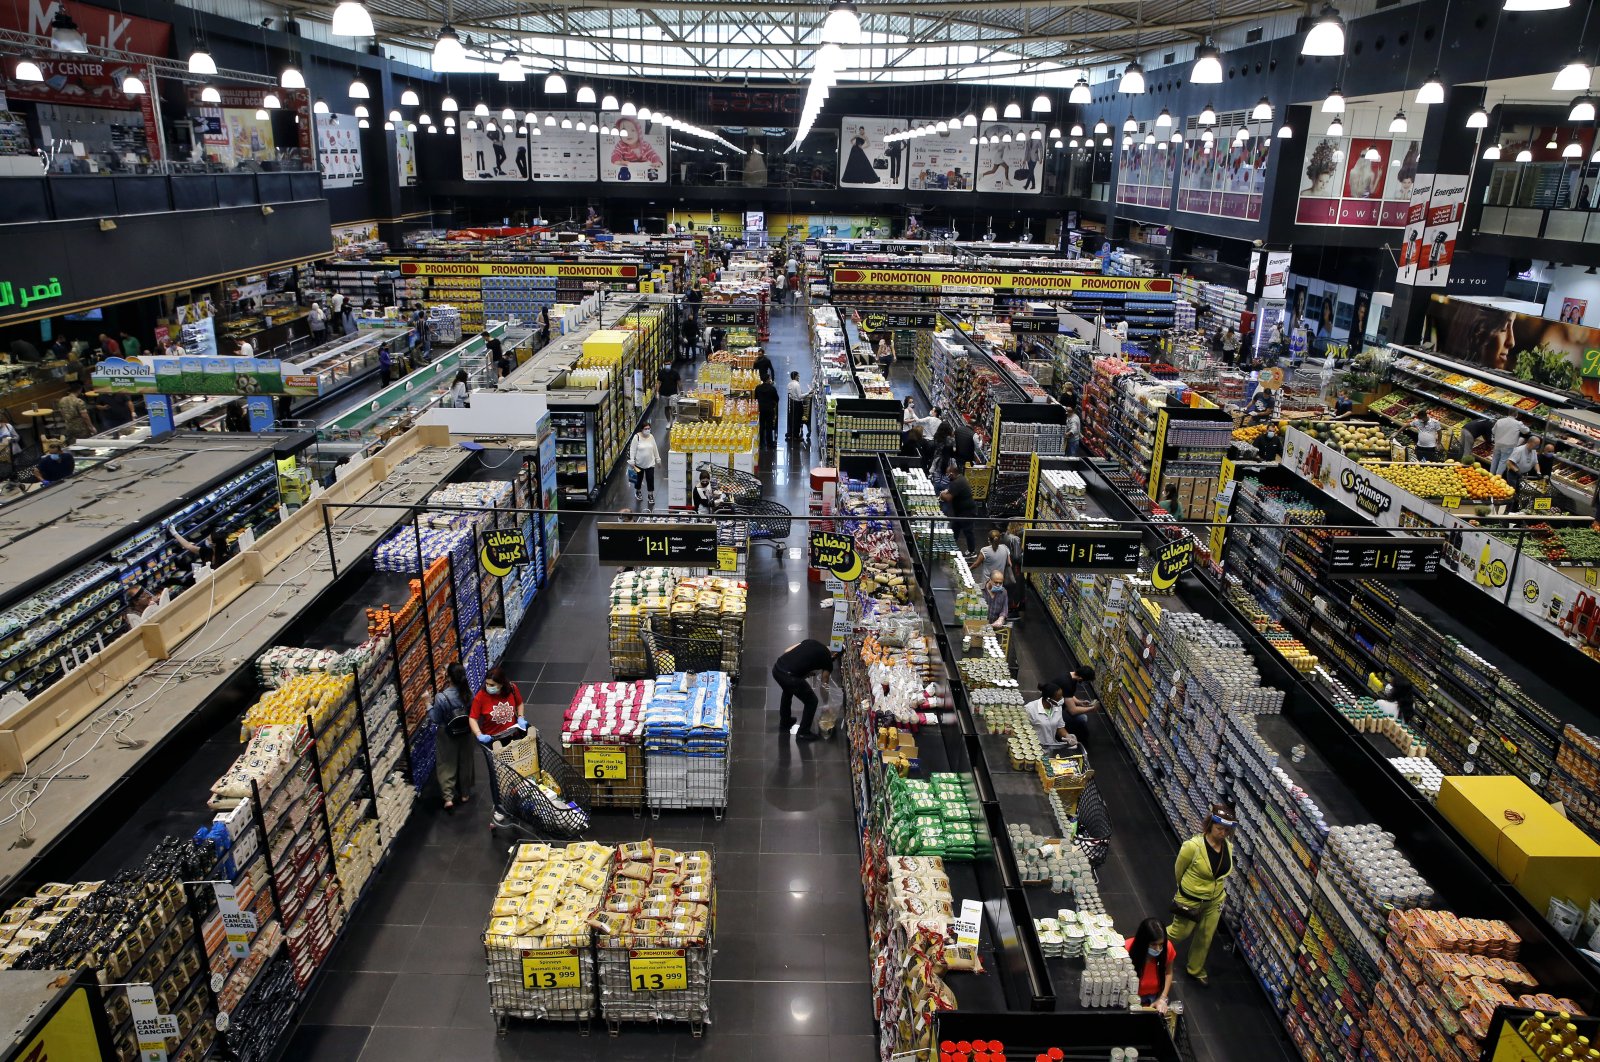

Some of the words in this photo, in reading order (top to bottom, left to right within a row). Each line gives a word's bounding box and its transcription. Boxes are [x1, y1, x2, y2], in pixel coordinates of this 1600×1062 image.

[58, 62, 104, 76] CENTER
[1434, 187, 1465, 197] Energizer
[425, 264, 479, 274] PROMOTION
[491, 265, 546, 275] PROMOTION
[558, 266, 613, 276] PROMOTION
[870, 272, 931, 283] PROMOTION
[941, 274, 1002, 286] PROMOTION
[1011, 276, 1072, 287] PROMOTION
[1081, 278, 1141, 290] PROMOTION
[19, 277, 62, 308] قصر
[95, 365, 120, 376] Plein
[122, 365, 150, 376] Soleil
[1354, 477, 1390, 508] Spinneys
[488, 531, 525, 547] رمضان
[650, 541, 664, 551] 21
[813, 533, 850, 552] رمضان
[499, 545, 521, 562] كريم
[819, 550, 844, 565] كريم
[1078, 548, 1085, 558] 3
[1161, 542, 1193, 560] رمضان
[1167, 553, 1188, 574] كريم
[1382, 555, 1389, 563] 1
[594, 764, 605, 778] 6
[527, 973, 558, 988] 13
[635, 973, 665, 990] 13
